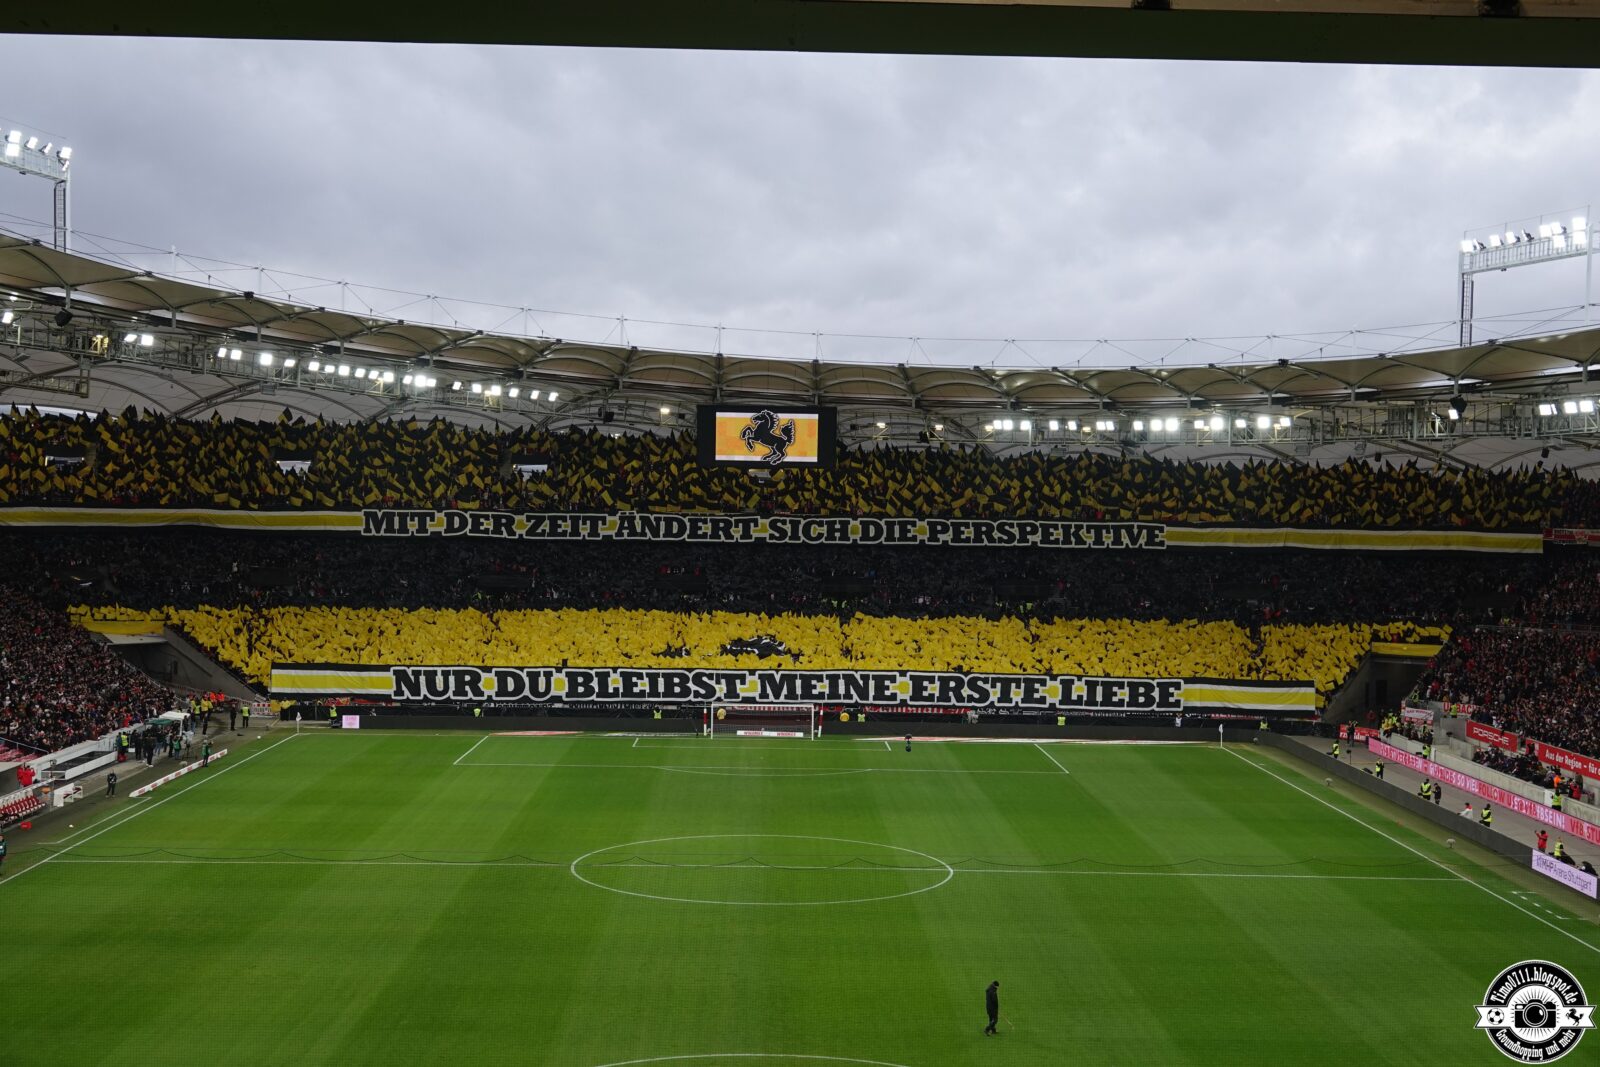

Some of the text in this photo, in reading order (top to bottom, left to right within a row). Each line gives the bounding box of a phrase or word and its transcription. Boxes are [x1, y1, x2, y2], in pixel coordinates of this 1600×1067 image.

[363, 510, 1166, 549] MIT DER ZEIT ÄNDERT SICH DIE PERSPEKTIVE
[391, 667, 1184, 711] NUR DU BLEIBST MEINE ERSTE LIEBE
[1472, 727, 1509, 746] PORSCHE
[1565, 755, 1582, 770] Region
